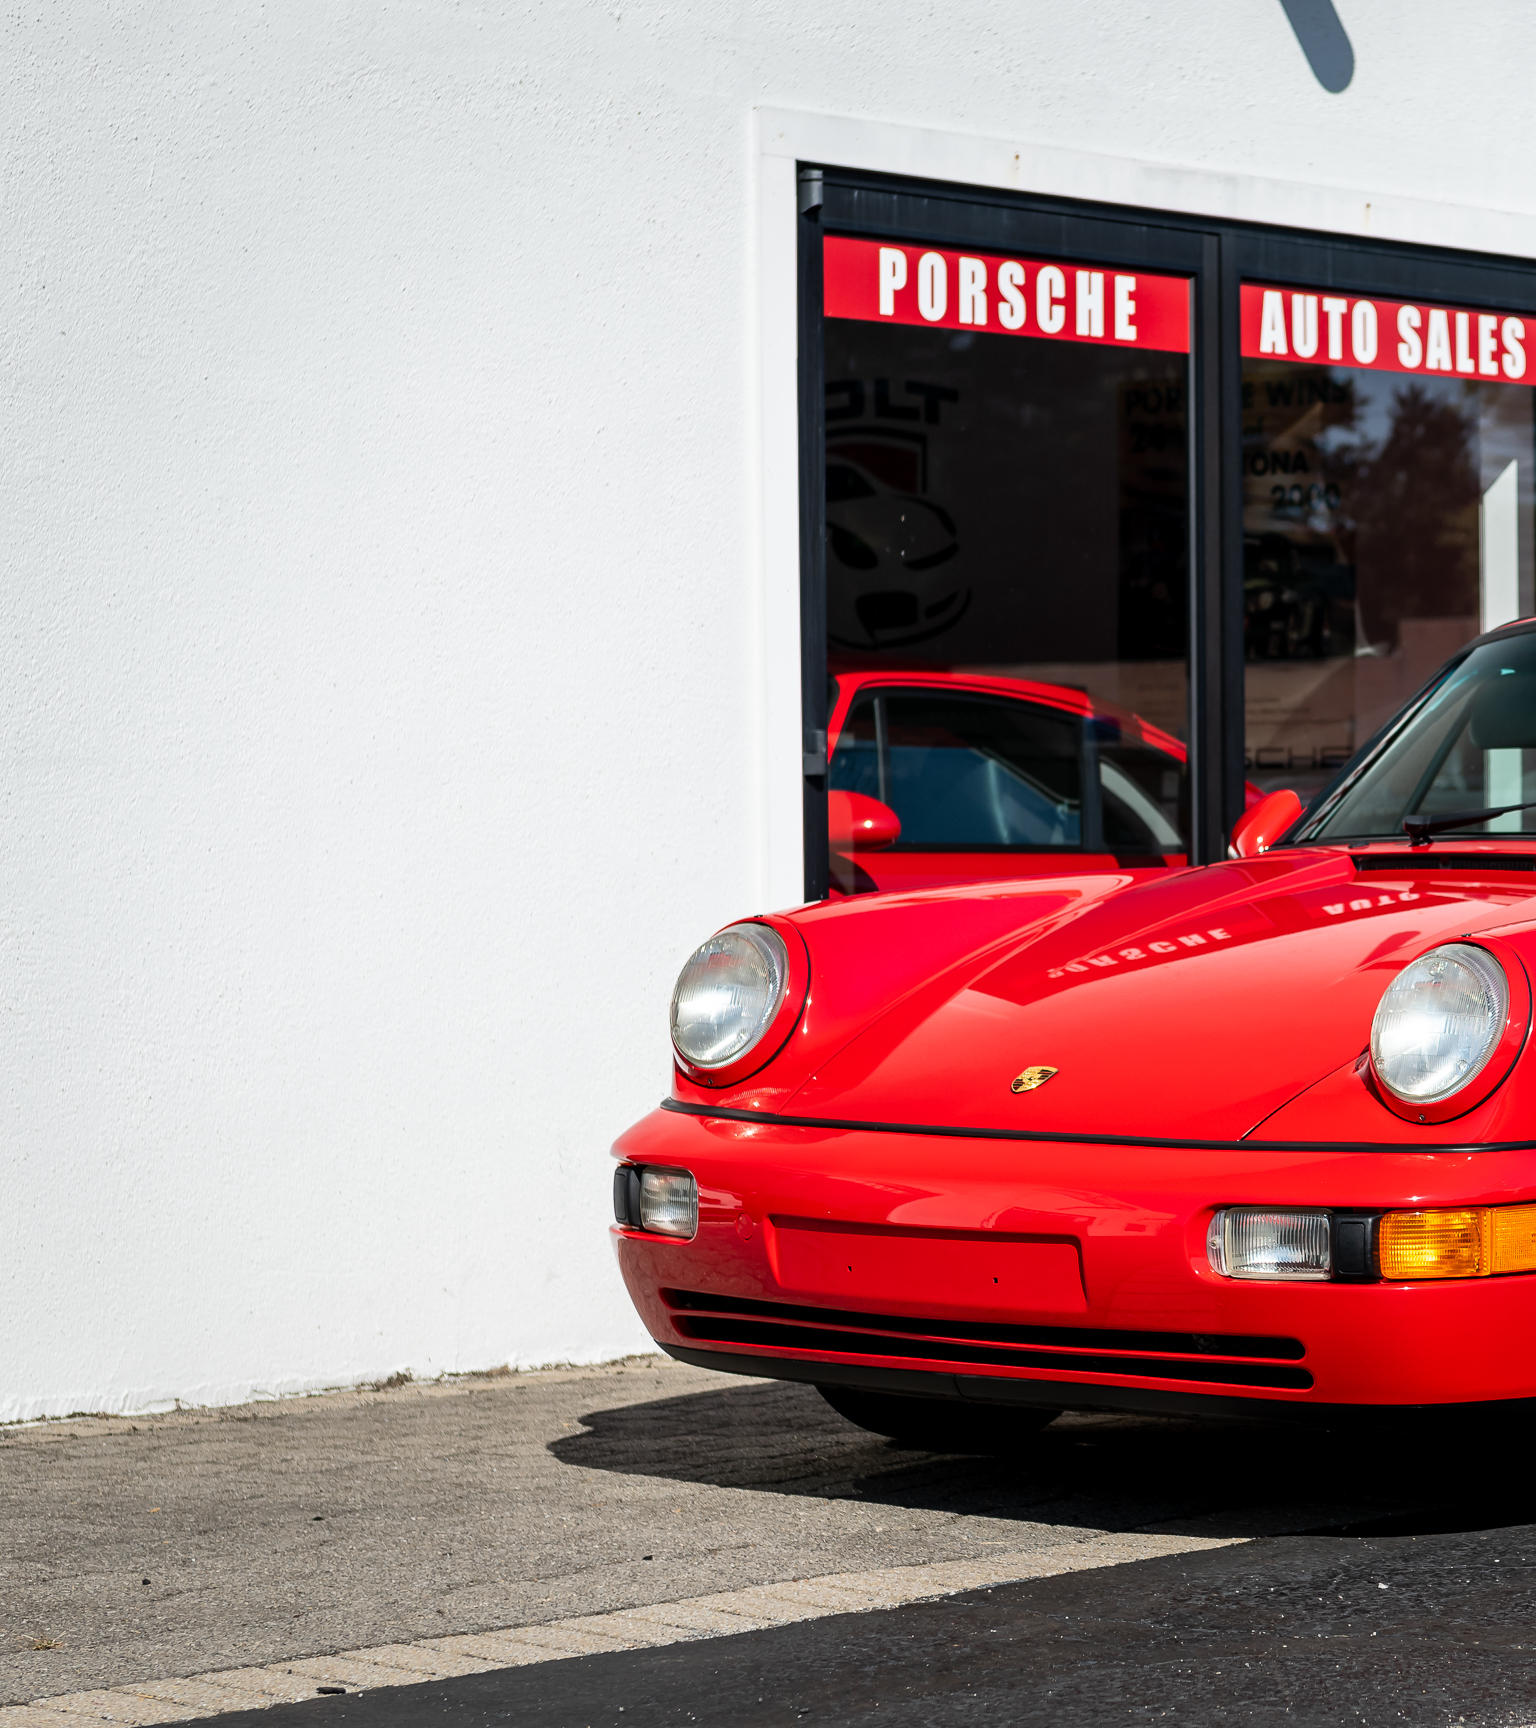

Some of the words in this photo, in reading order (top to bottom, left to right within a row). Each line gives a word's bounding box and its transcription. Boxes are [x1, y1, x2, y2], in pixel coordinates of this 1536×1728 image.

[877, 246, 1138, 342] PORSCHE
[1259, 289, 1378, 364] AUTO
[1397, 301, 1527, 379] SALES
